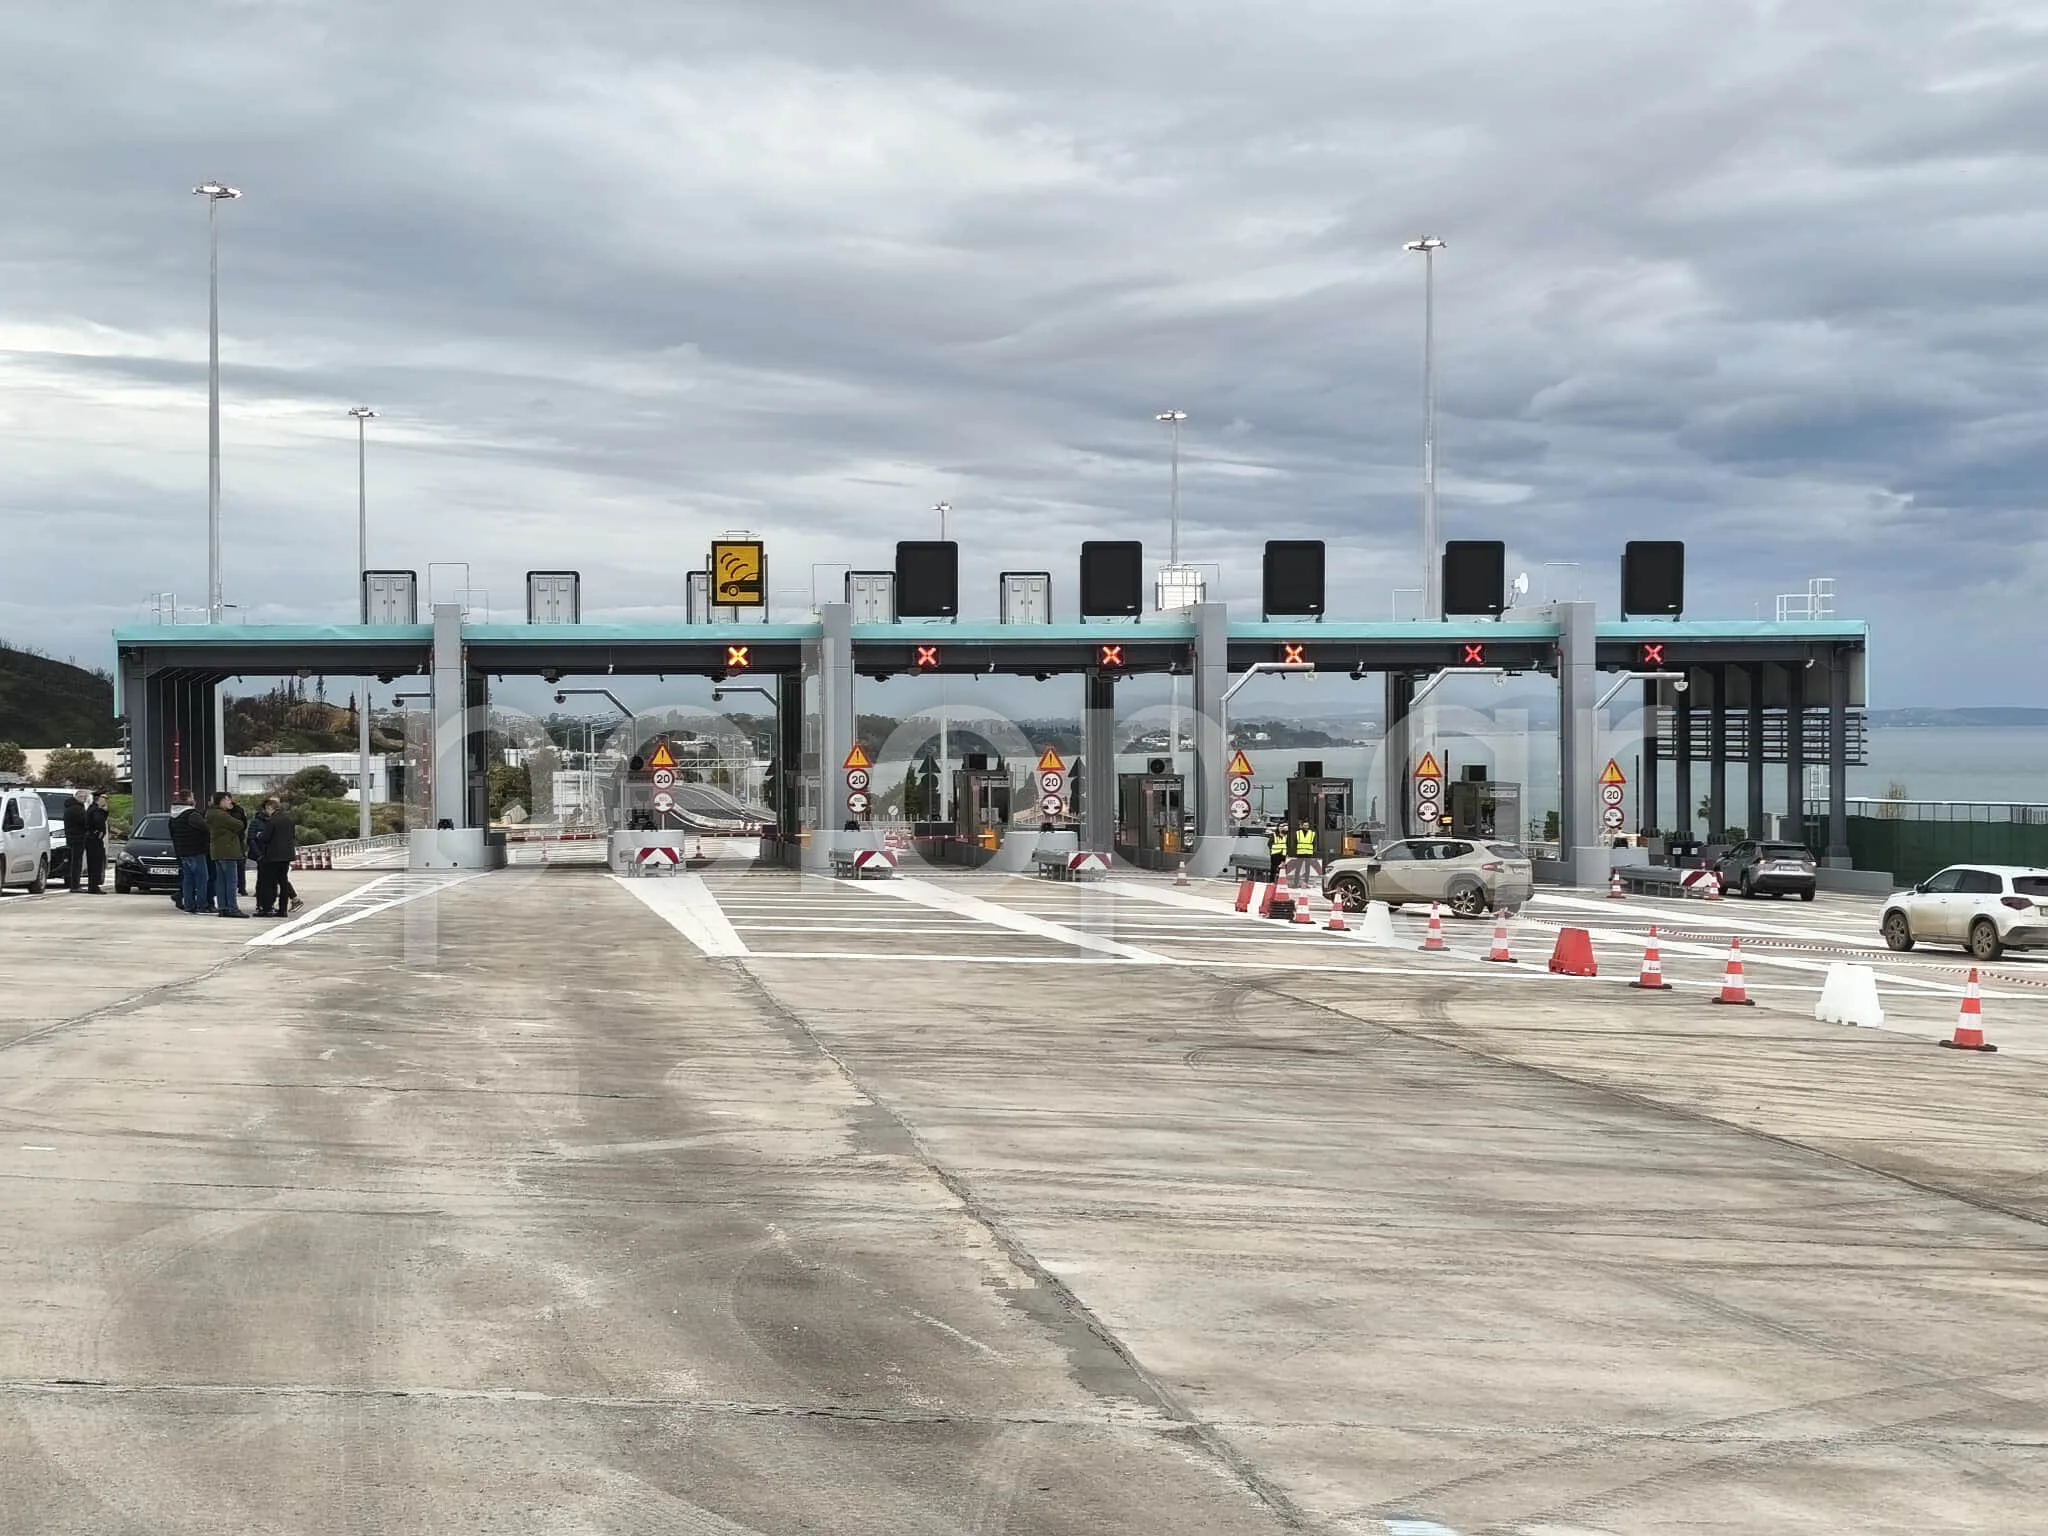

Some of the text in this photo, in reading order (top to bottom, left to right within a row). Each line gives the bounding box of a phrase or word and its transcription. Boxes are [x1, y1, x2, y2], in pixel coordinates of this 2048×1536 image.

[656, 774, 670, 784] 20
[851, 775, 865, 785] 20
[1044, 777, 1058, 787] 20
[1233, 782, 1246, 791] 20
[1422, 784, 1436, 794] 20
[1606, 790, 1619, 800] 20
